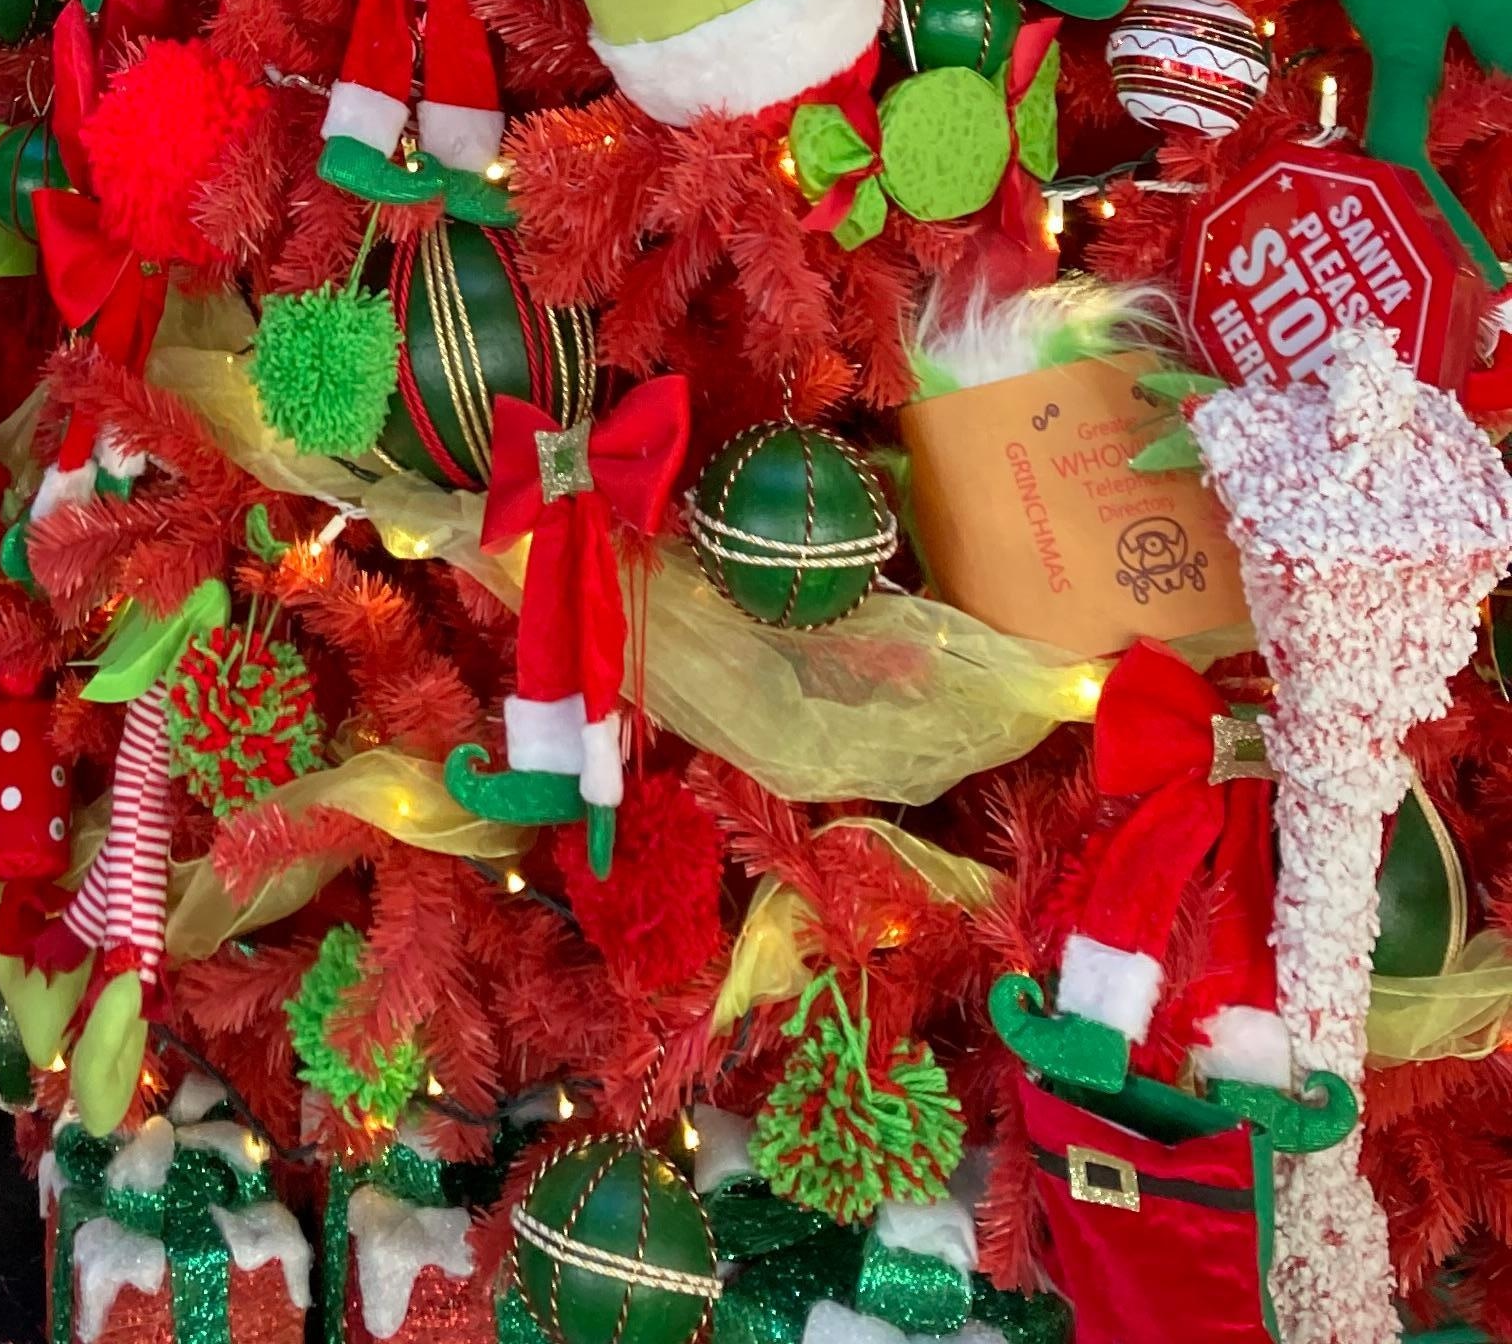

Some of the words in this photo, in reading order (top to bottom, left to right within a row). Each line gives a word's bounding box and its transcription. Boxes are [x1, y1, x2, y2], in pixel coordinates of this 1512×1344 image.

[1289, 211, 1374, 328] PLEAS
[1328, 195, 1413, 314] SANTA
[1210, 299, 1277, 388] HERE
[1005, 442, 1074, 594] GRINCHMAS
[1097, 495, 1176, 524] Directory
